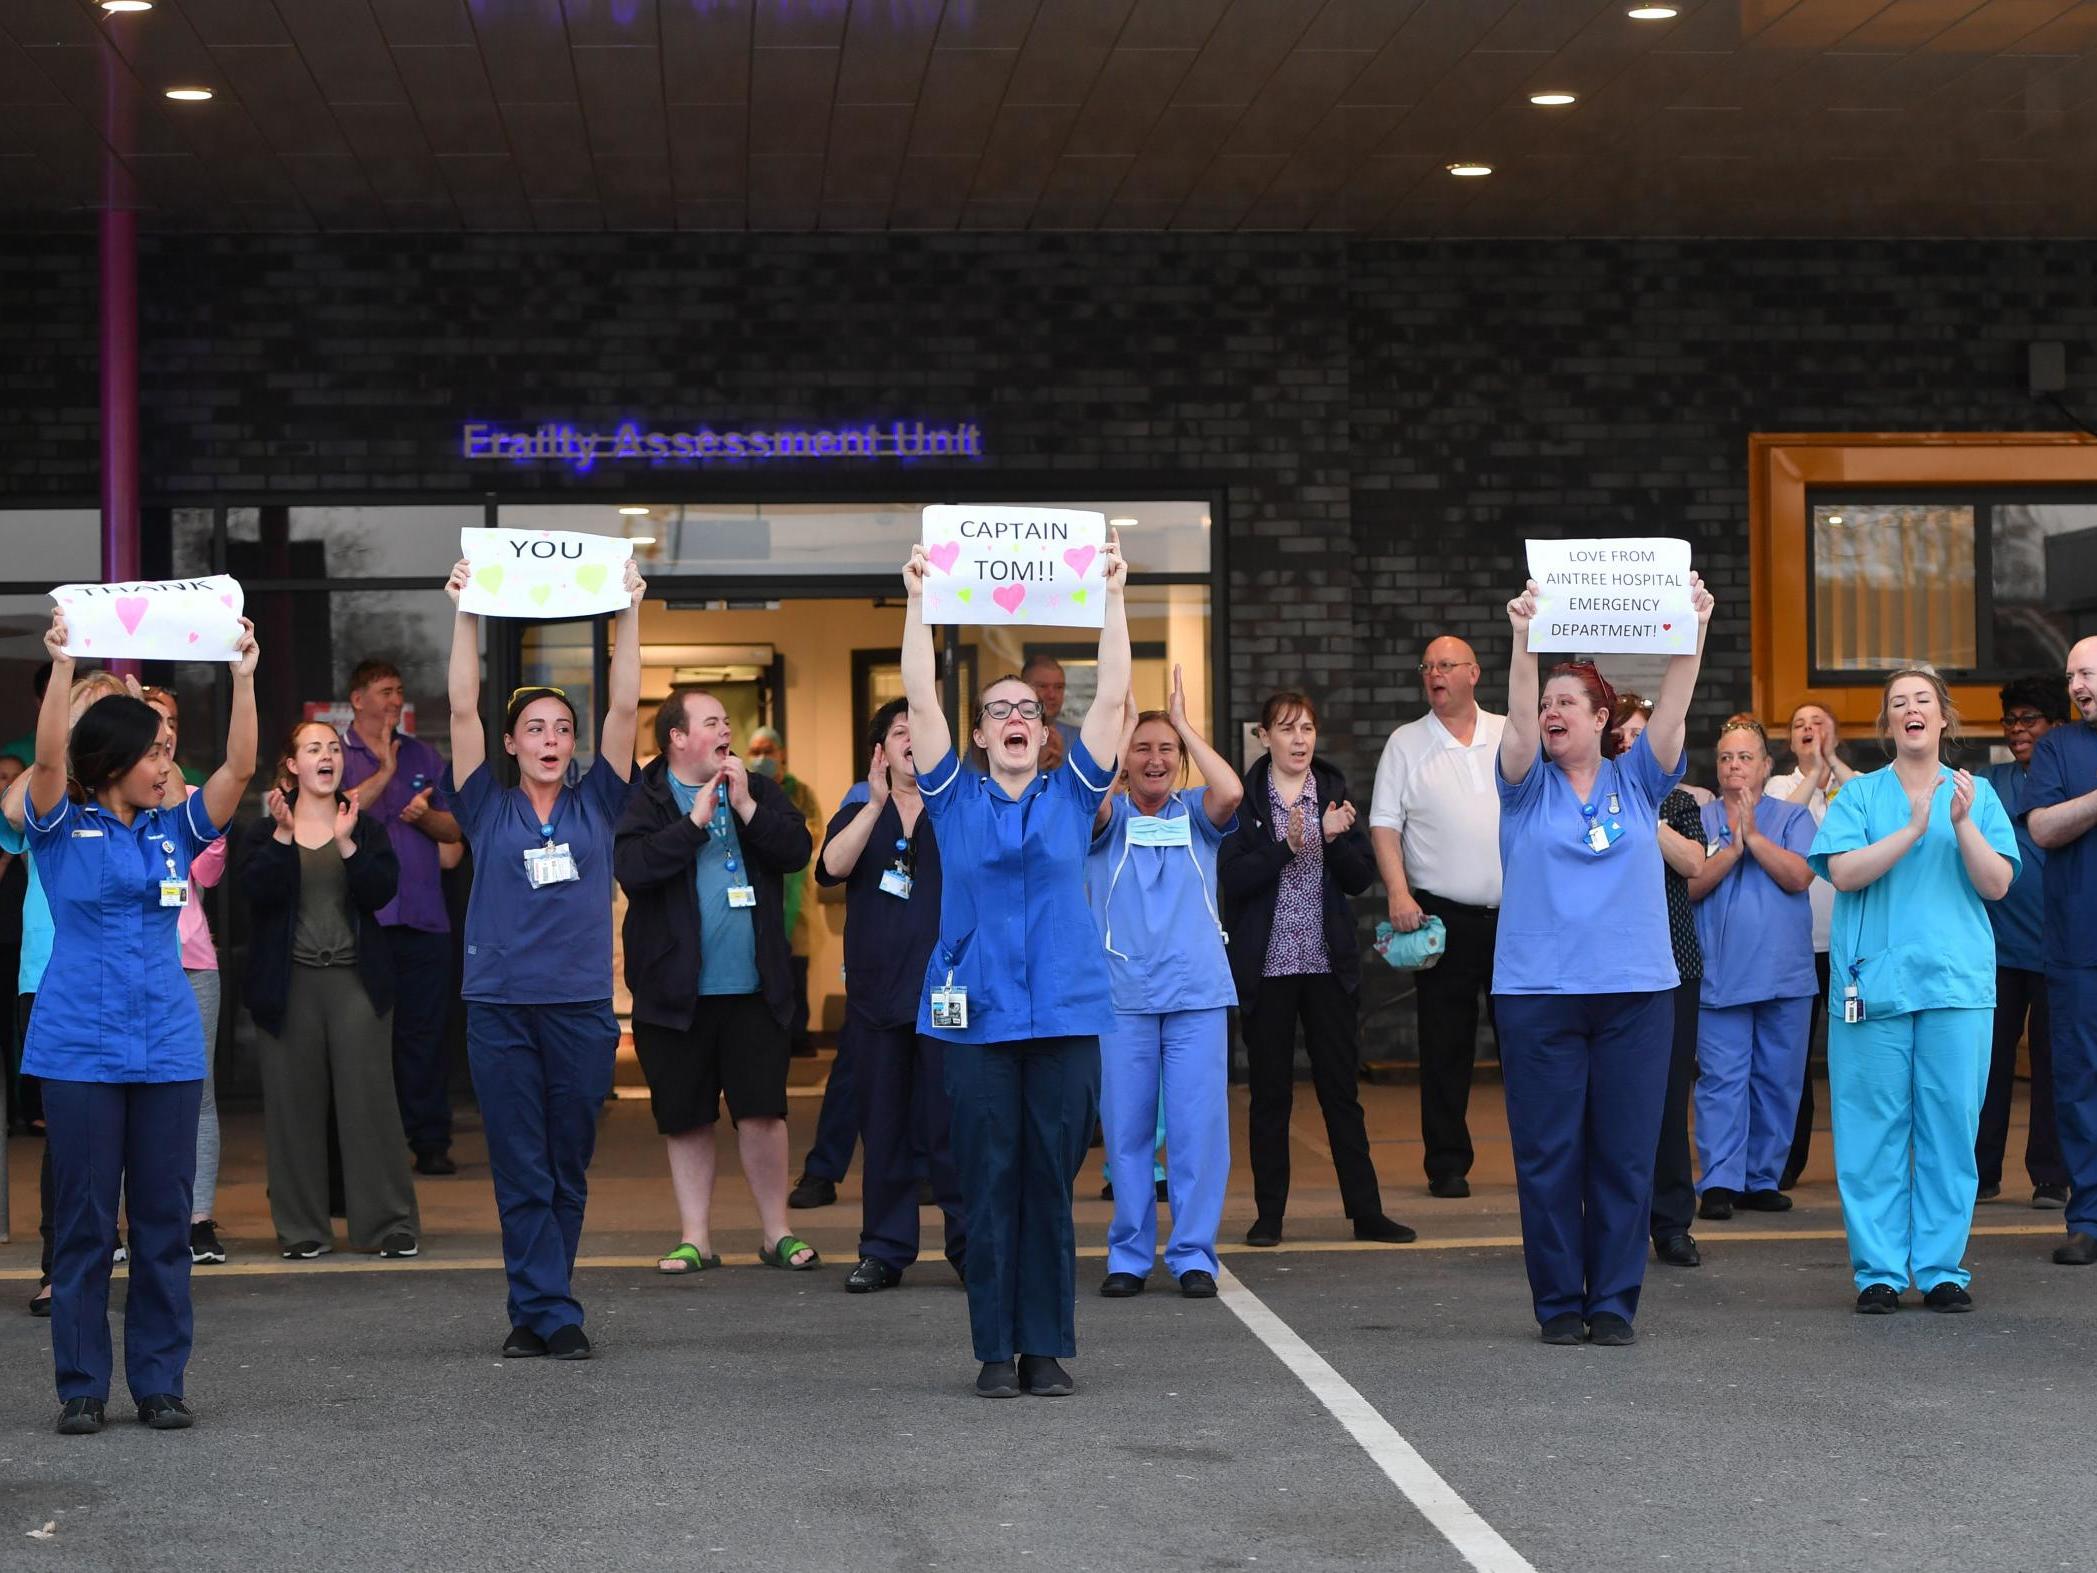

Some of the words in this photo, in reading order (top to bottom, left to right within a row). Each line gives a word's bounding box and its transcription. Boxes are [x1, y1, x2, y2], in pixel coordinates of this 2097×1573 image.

[463, 423, 599, 468] Frailty
[613, 422, 880, 457] Assessment
[896, 421, 981, 456] Unit
[960, 520, 1068, 540] CAPTAIN
[510, 540, 583, 559] YOU
[1569, 550, 1606, 563] LOVE
[1612, 550, 1655, 563] FROM
[974, 560, 1054, 582] TOM!!
[1546, 572, 1607, 586] AINTREE
[1612, 573, 1682, 587] HOSPITAL
[74, 580, 214, 597] THANK
[1569, 597, 1660, 612] EMERGENCY
[1551, 623, 1657, 638] DEPARTMENT!
